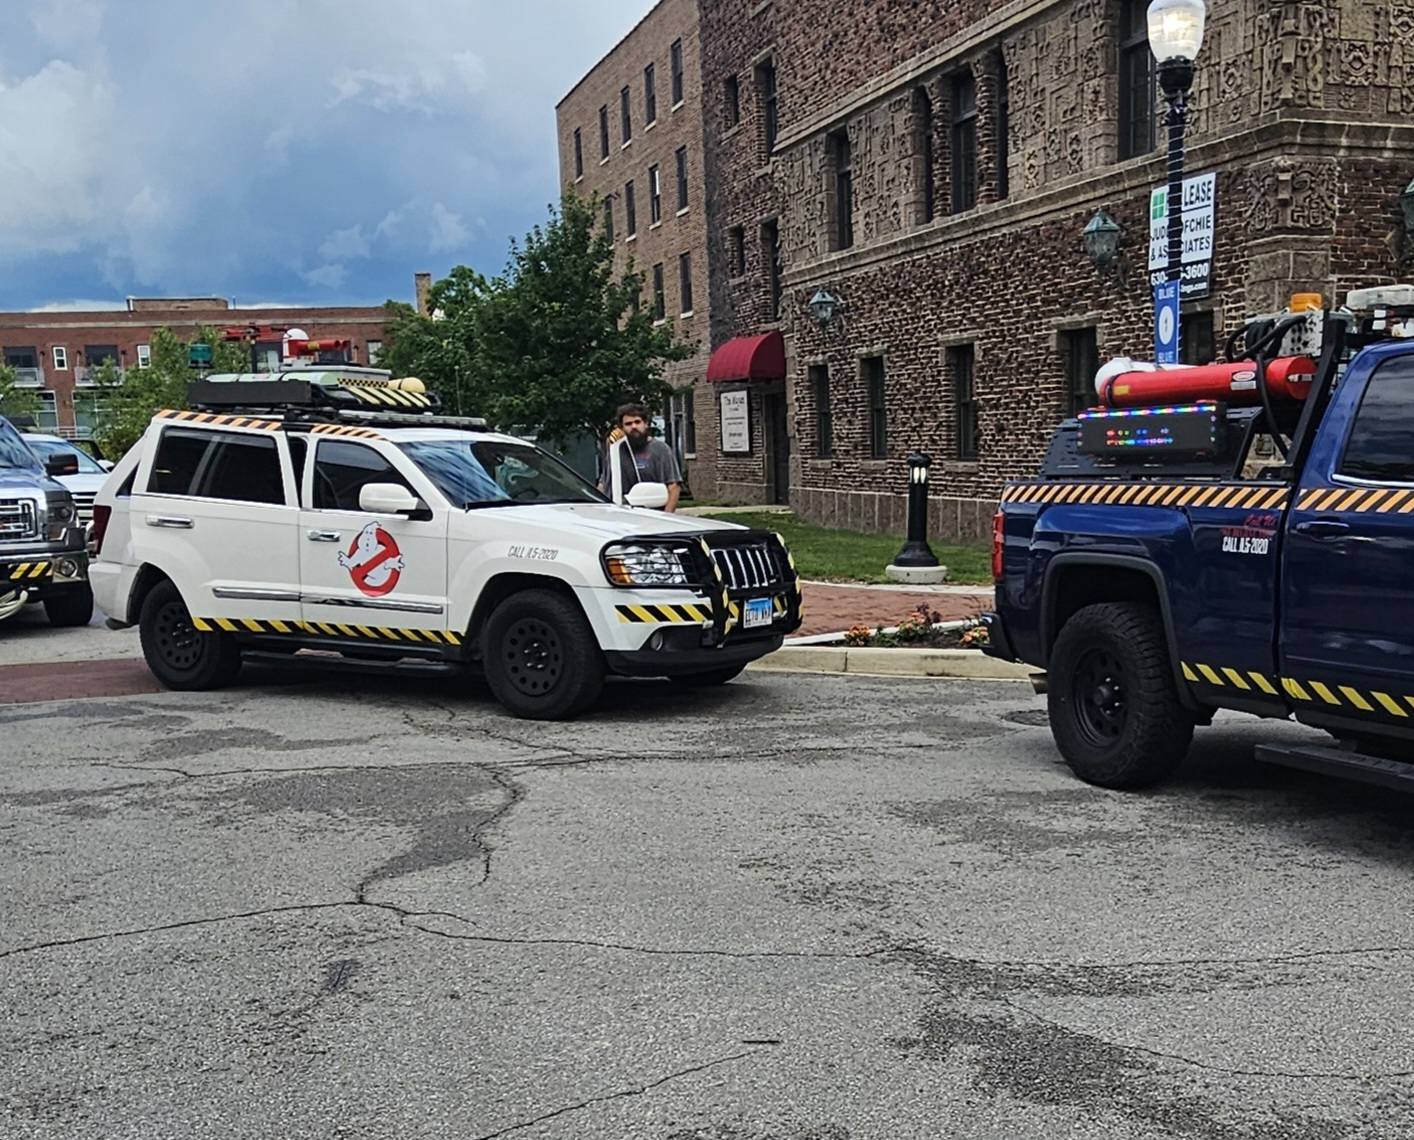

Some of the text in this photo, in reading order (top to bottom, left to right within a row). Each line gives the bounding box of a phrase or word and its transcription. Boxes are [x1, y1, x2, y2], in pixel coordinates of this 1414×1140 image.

[1183, 181, 1212, 207] LEASE
[507, 545, 525, 558] CALL
[1222, 536, 1238, 552] CALL
